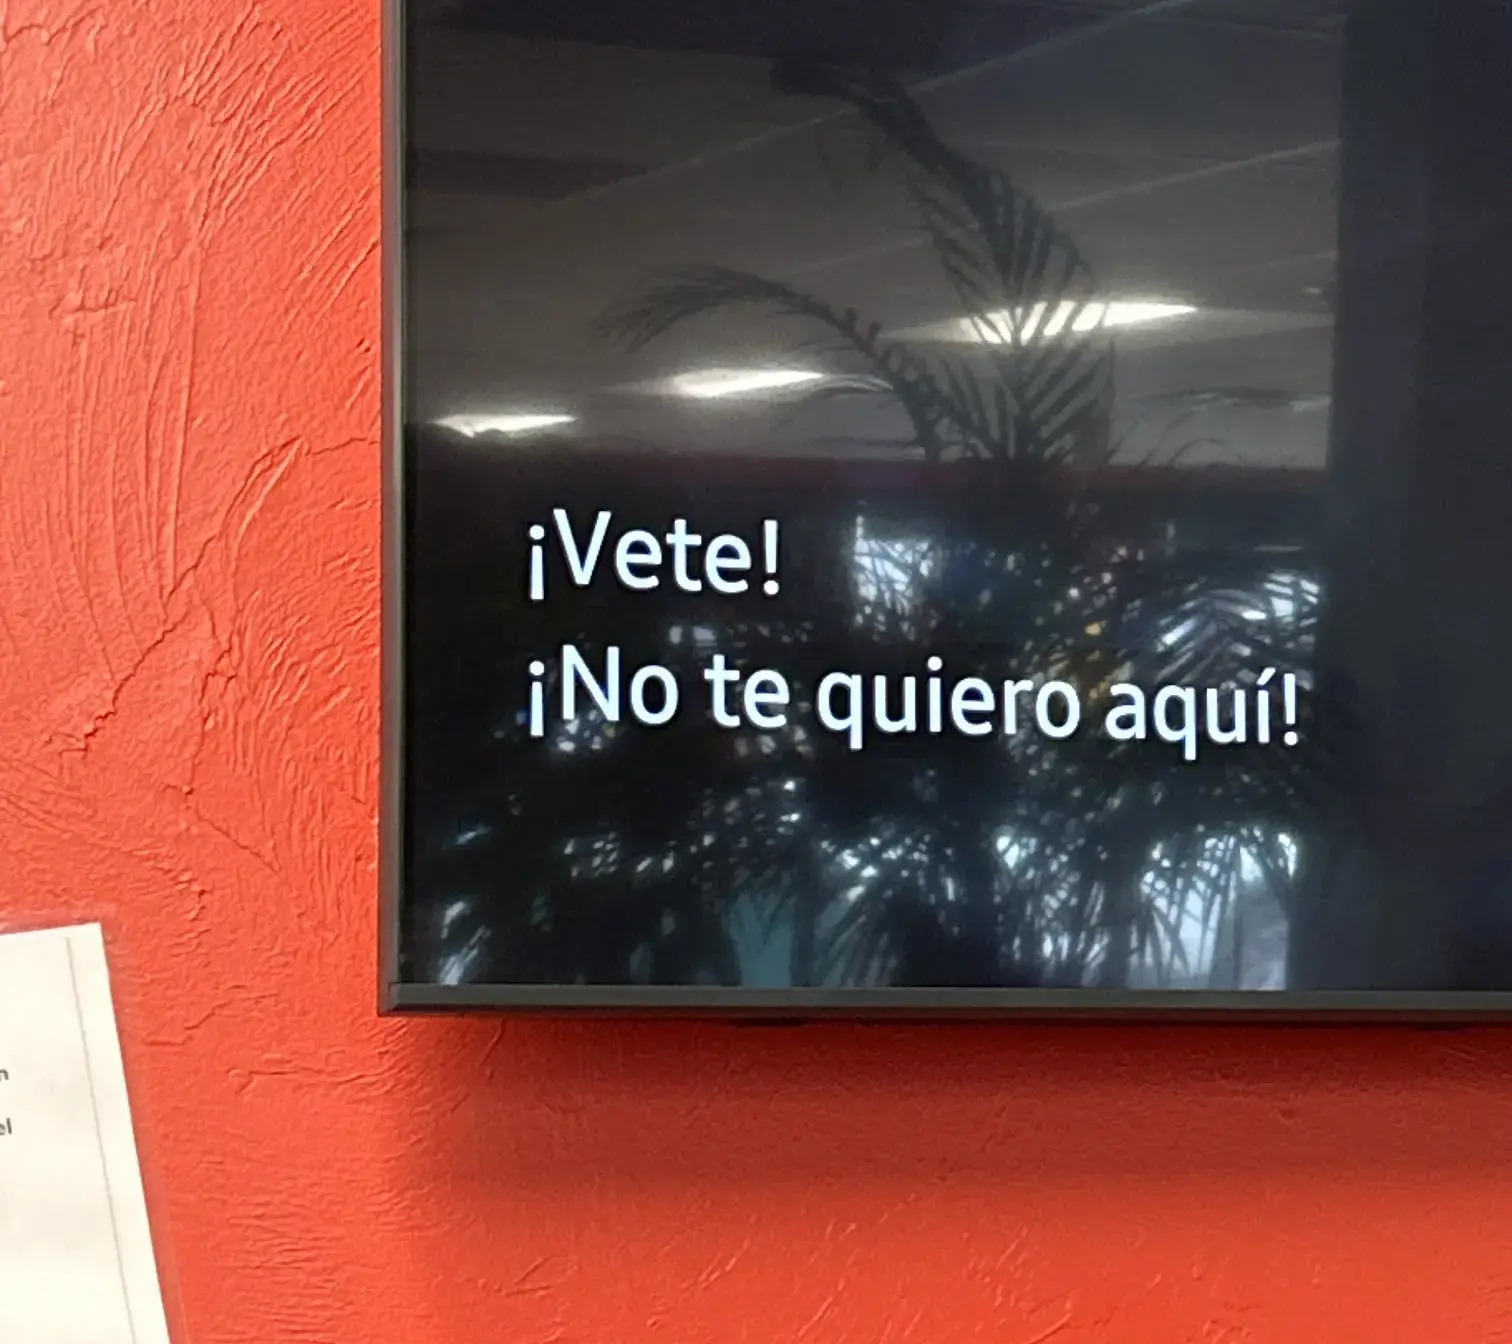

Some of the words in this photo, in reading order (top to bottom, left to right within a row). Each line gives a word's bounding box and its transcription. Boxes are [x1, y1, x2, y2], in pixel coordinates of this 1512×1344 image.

[526, 507, 781, 602] ¡Vete!
[526, 644, 680, 738] ¡No
[703, 653, 791, 730] te
[816, 656, 1082, 751] quiero
[1104, 667, 1302, 761] aquí!
